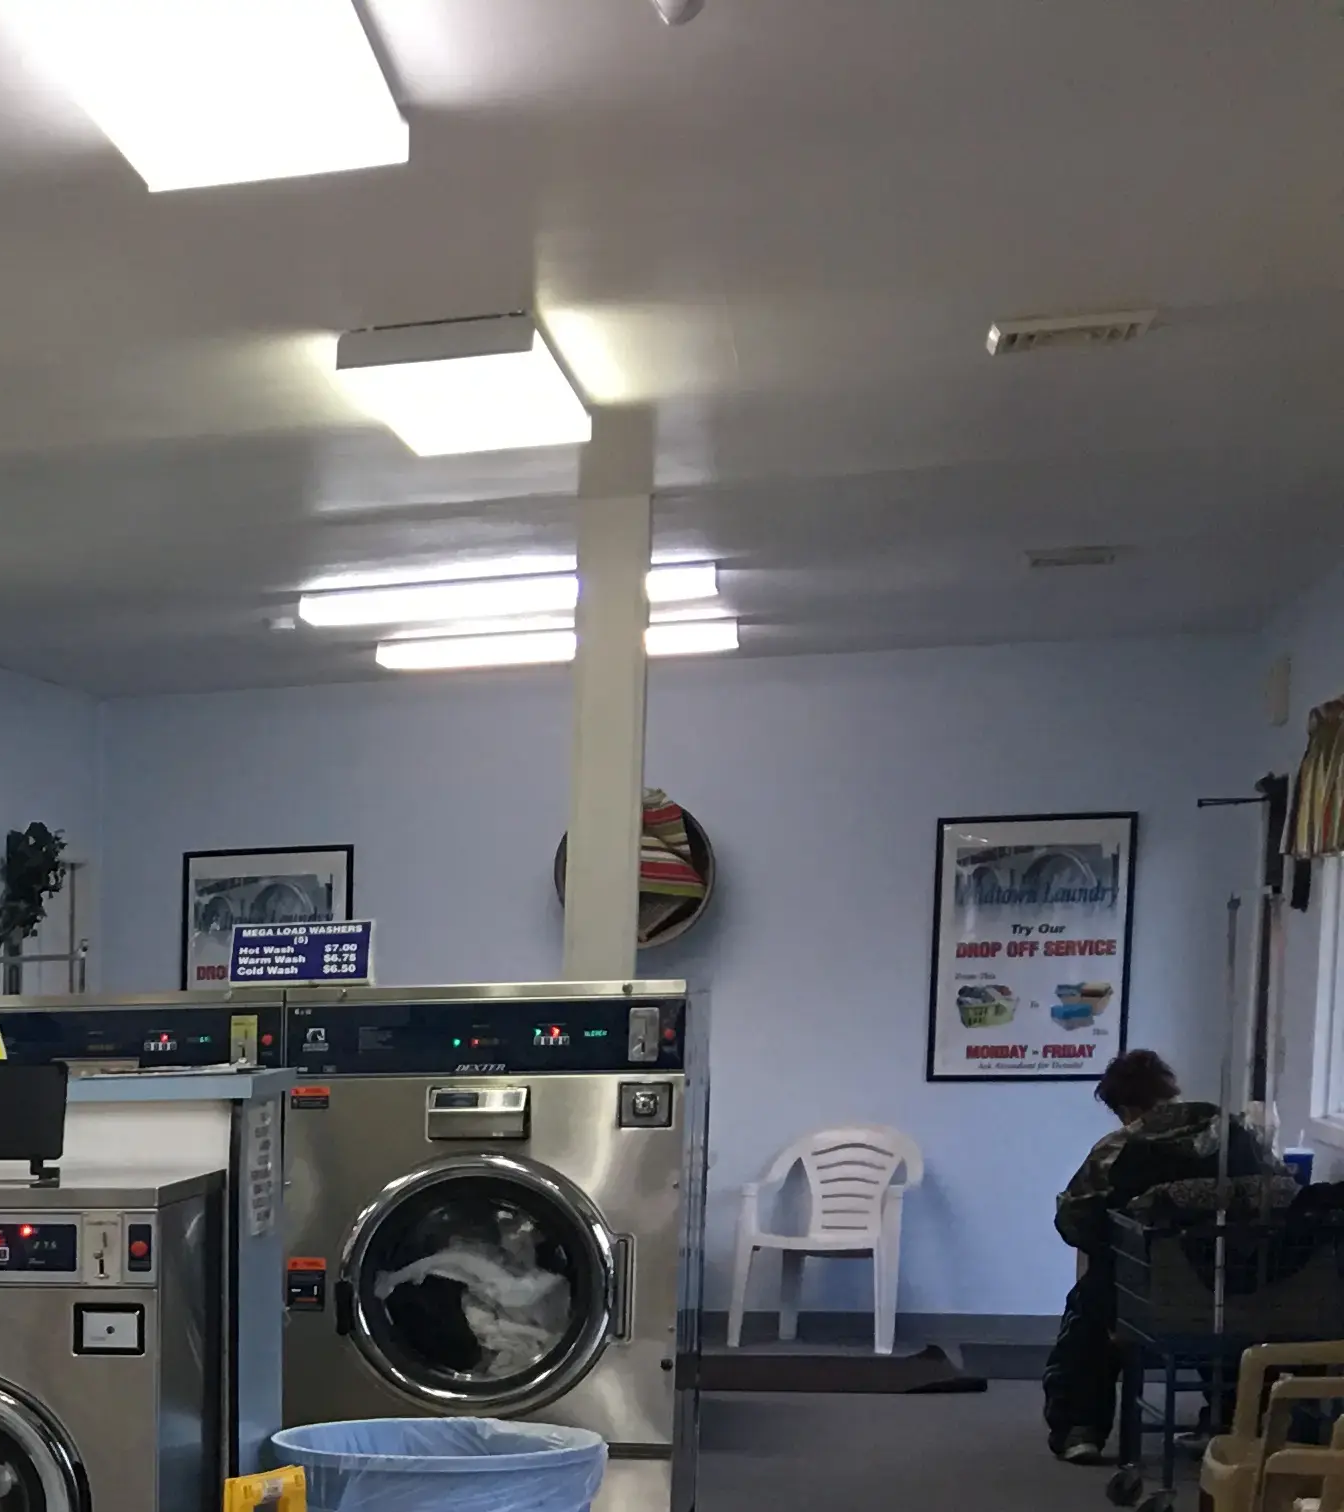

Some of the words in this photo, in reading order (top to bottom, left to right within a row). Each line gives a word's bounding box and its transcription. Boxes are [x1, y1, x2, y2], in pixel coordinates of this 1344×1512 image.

[242, 928, 274, 938] MEGA
[276, 927, 306, 936] LOAD
[309, 925, 362, 935] WASHERS
[1011, 923, 1034, 936] Try
[1038, 923, 1066, 934] Our
[239, 947, 260, 955] Hot
[263, 946, 294, 954] Wash
[325, 943, 358, 953] $7.00
[956, 941, 1002, 958] DROP
[1006, 941, 1040, 958] OFF
[1044, 939, 1117, 957] SERVICE
[238, 957, 271, 965] Warm
[274, 955, 306, 964] Wash
[324, 953, 357, 963] $6.75
[196, 965, 227, 981] DRO
[237, 966, 263, 976] Cold
[266, 965, 298, 975] Wash
[323, 964, 356, 974] $6.50
[966, 1045, 1028, 1060] MONDAY
[1042, 1044, 1096, 1059] FRIDAY
[454, 1063, 507, 1072] DEXTER
